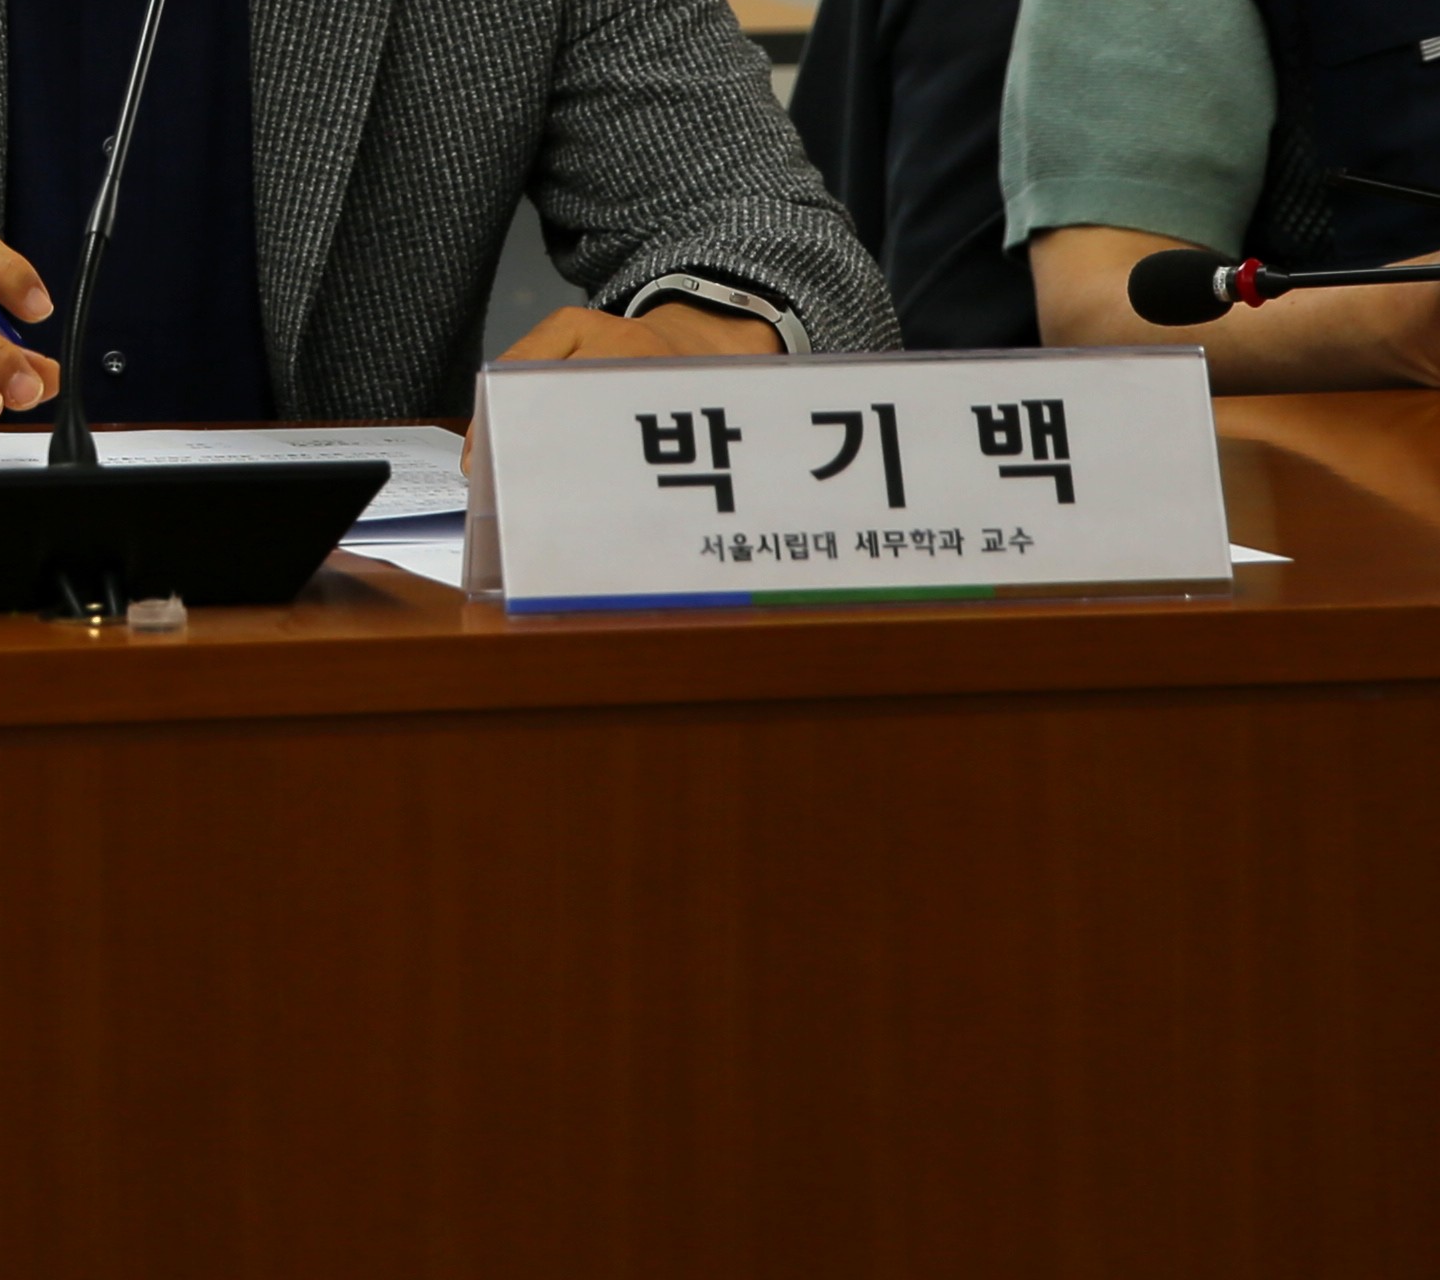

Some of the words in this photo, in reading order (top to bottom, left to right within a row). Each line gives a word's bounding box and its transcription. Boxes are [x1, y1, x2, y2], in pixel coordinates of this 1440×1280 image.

[700, 530, 839, 563] 서울시립대
[854, 527, 965, 559] 세무학과
[981, 526, 1034, 555] 교수
